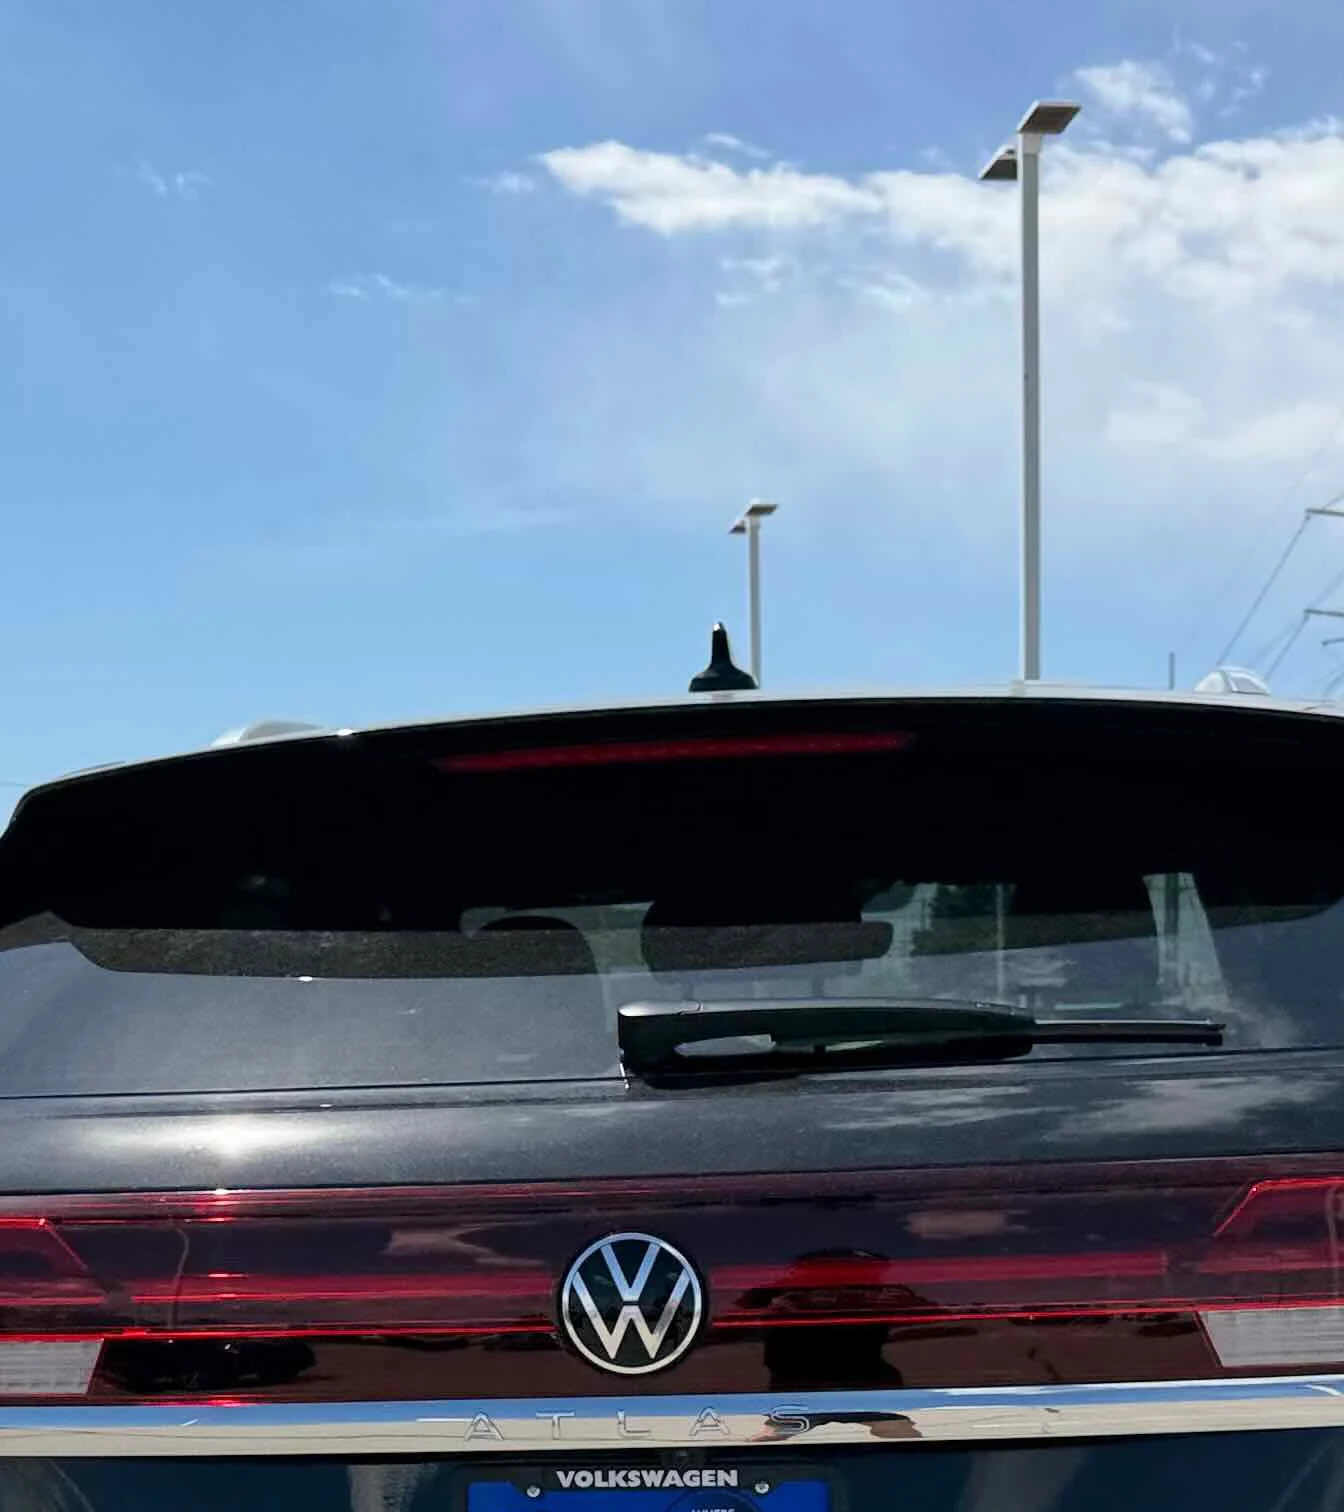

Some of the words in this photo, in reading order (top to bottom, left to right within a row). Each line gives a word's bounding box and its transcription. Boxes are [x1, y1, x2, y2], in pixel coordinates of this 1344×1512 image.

[568, 1239, 695, 1362] VW
[463, 1405, 810, 1441] ATLAS
[556, 1469, 739, 1489] VOLKSWAGEN
